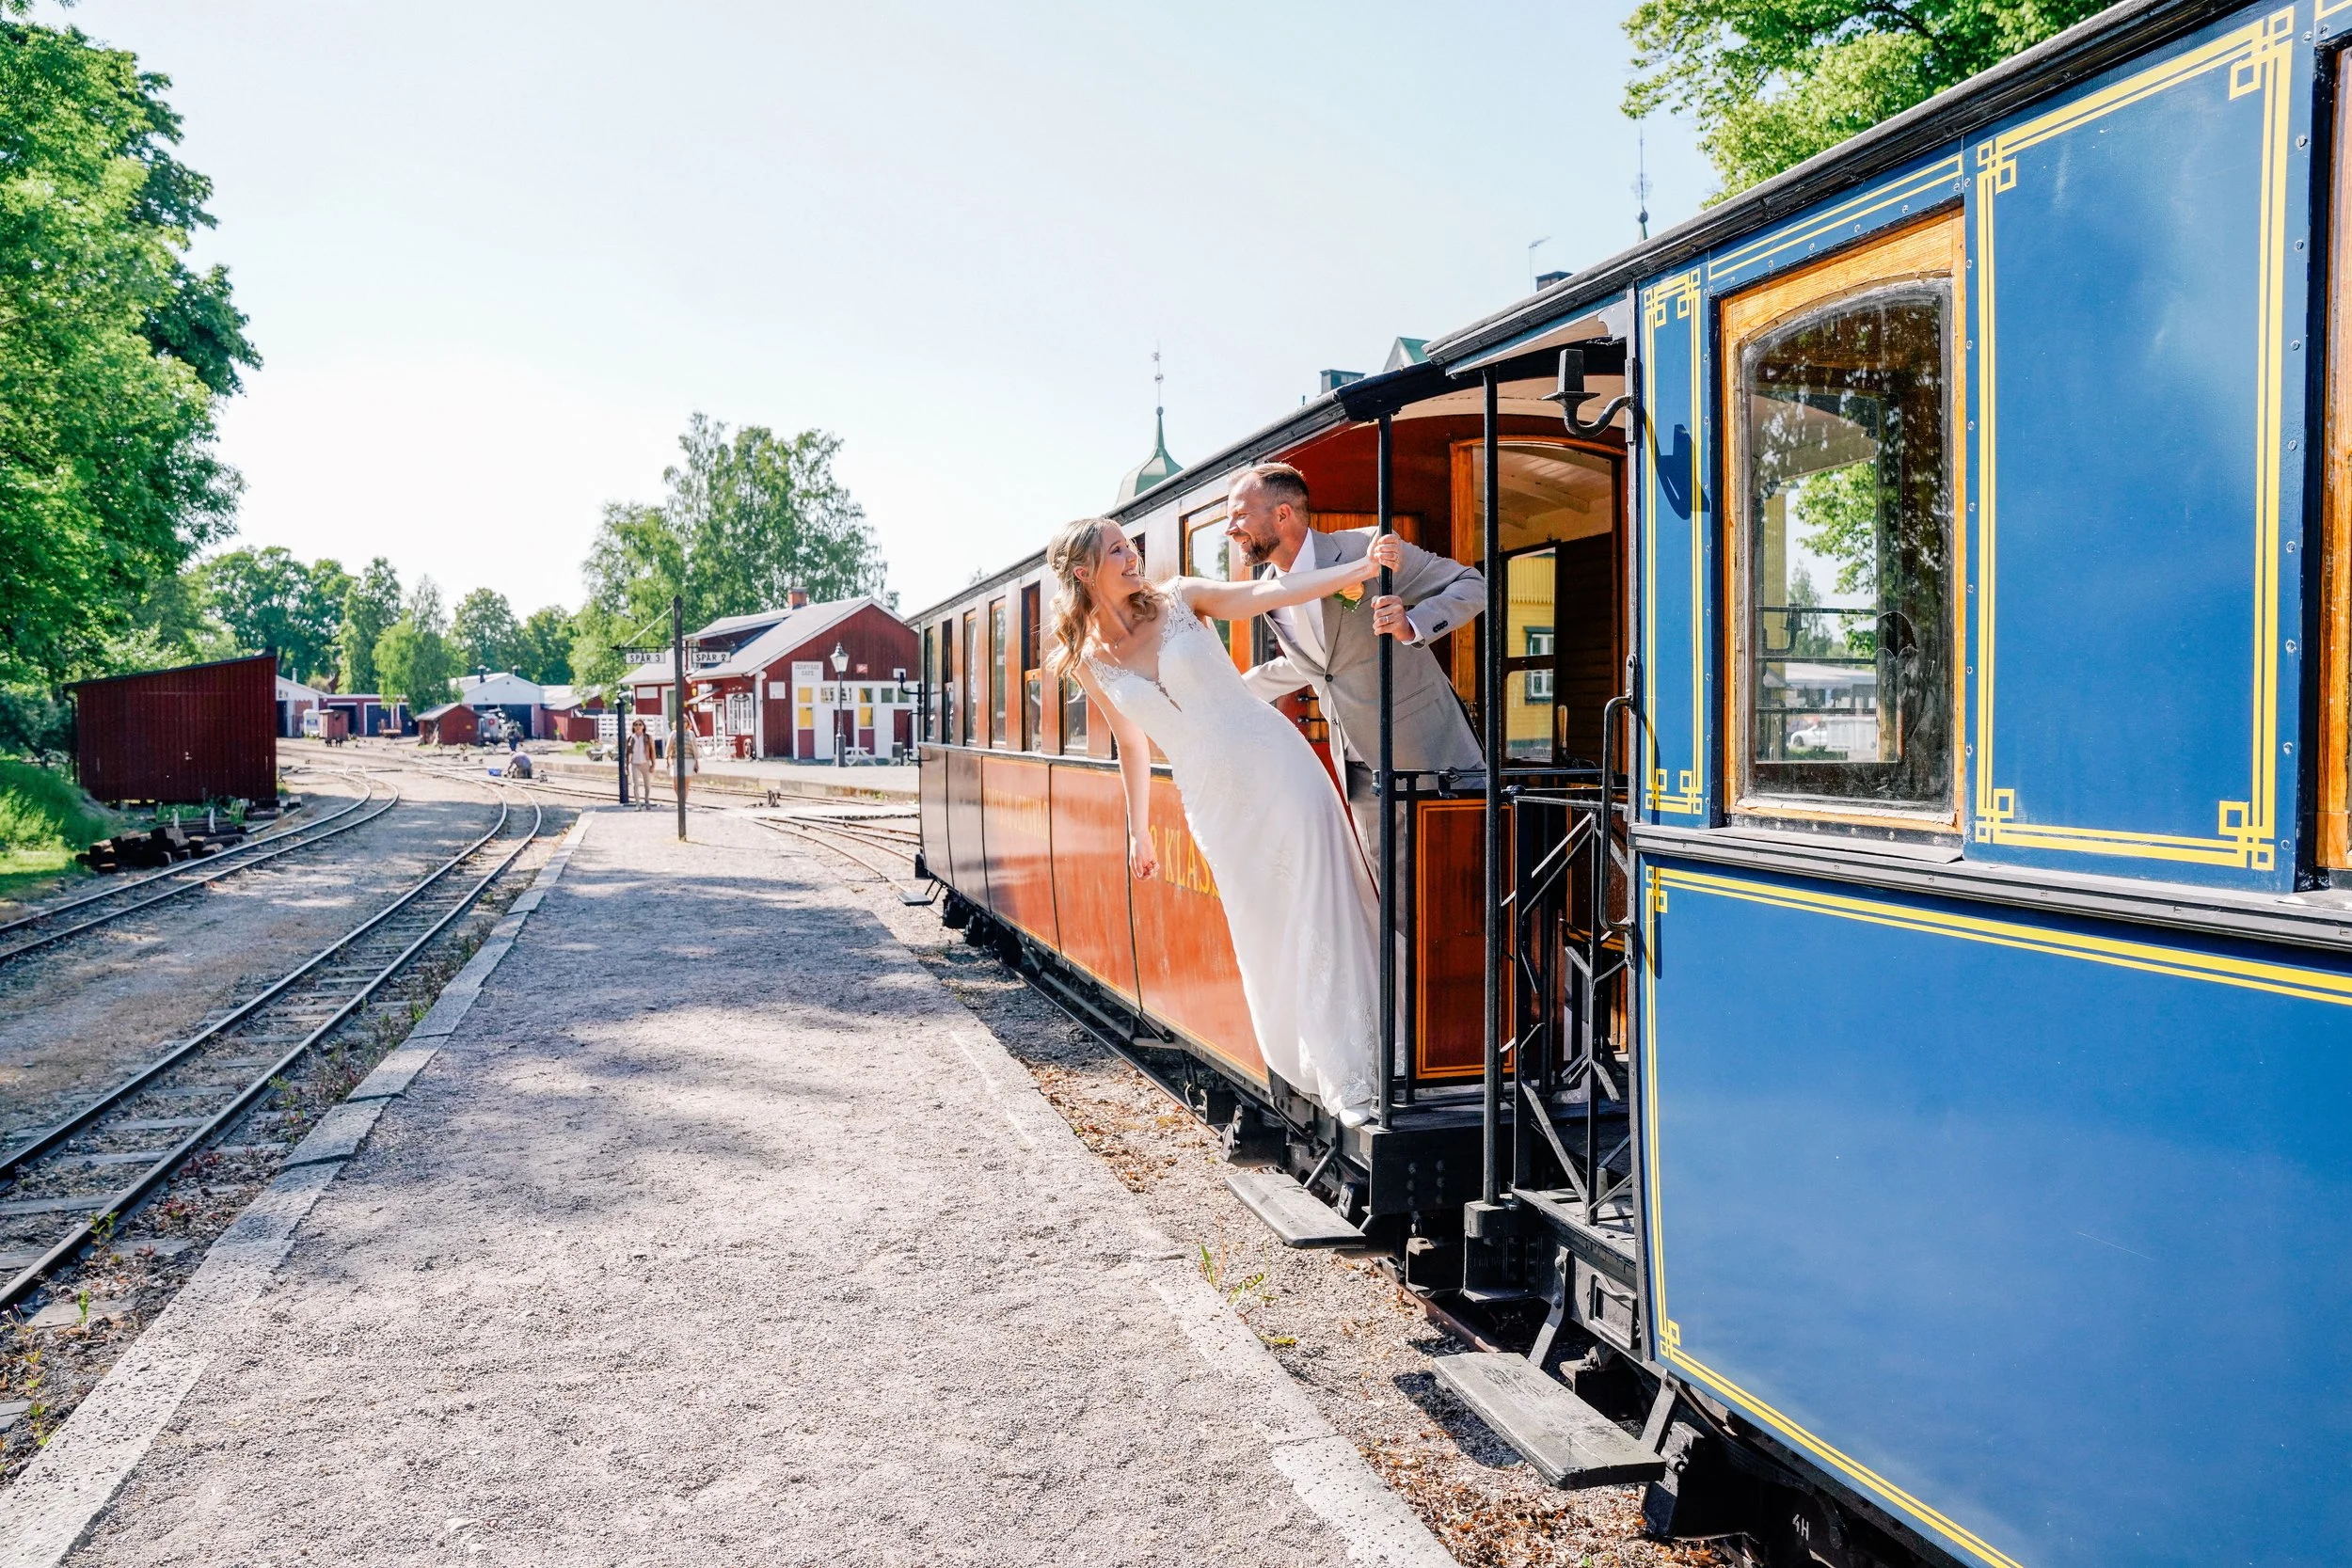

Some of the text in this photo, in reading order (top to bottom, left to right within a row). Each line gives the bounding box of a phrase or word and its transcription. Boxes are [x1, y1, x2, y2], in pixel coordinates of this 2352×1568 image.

[655, 654, 660, 662] 3
[721, 653, 726, 661] 2
[1165, 827, 1220, 897] KLAS
[1792, 1513, 1809, 1541] 4H
